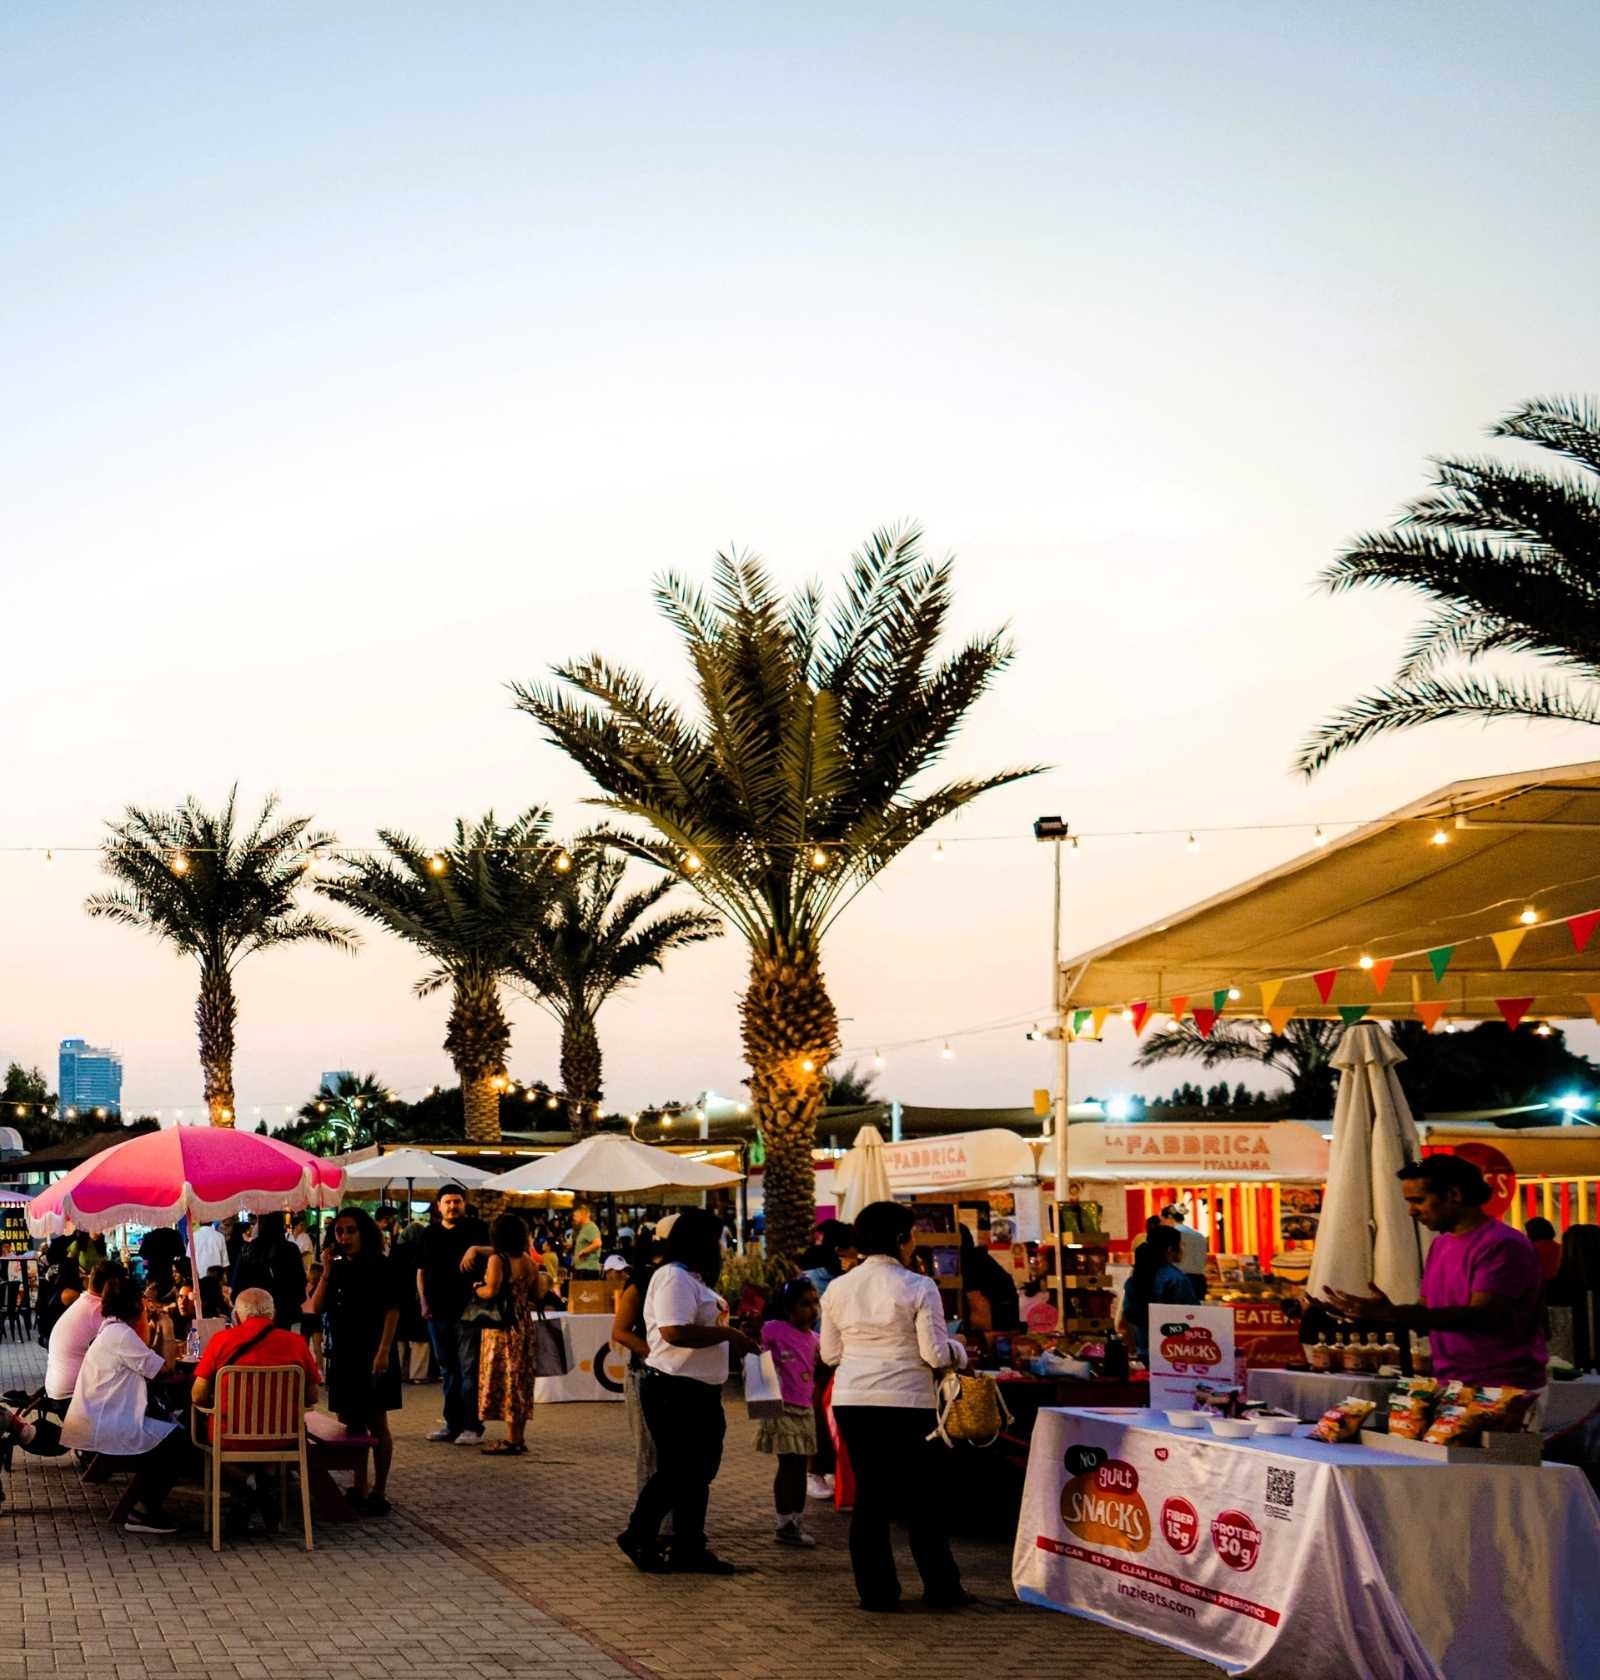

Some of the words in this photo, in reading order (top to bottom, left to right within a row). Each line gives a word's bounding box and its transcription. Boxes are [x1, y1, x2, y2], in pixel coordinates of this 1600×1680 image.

[1105, 1136, 1123, 1146] LA
[1127, 1135, 1270, 1154] FABBRICA
[894, 1147, 967, 1169] FABBRICA
[1203, 1160, 1271, 1170] ITALIANA
[6, 1218, 24, 1227] EAT
[0, 1230, 31, 1240] SUNNY
[3, 1242, 29, 1252] ARK
[1236, 1309, 1301, 1325] EATE
[1166, 1343, 1218, 1361] SNACKS
[1063, 1492, 1144, 1540] SNACKS
[1166, 1508, 1194, 1526] FIBER
[1211, 1521, 1261, 1544] PROTEIN
[1054, 1543, 1084, 1558] VEGAN
[1091, 1554, 1112, 1567] KETO
[1121, 1564, 1148, 1578] CLEAN
[1148, 1572, 1173, 1587] LABEL
[1118, 1580, 1196, 1619] inzieats.com
